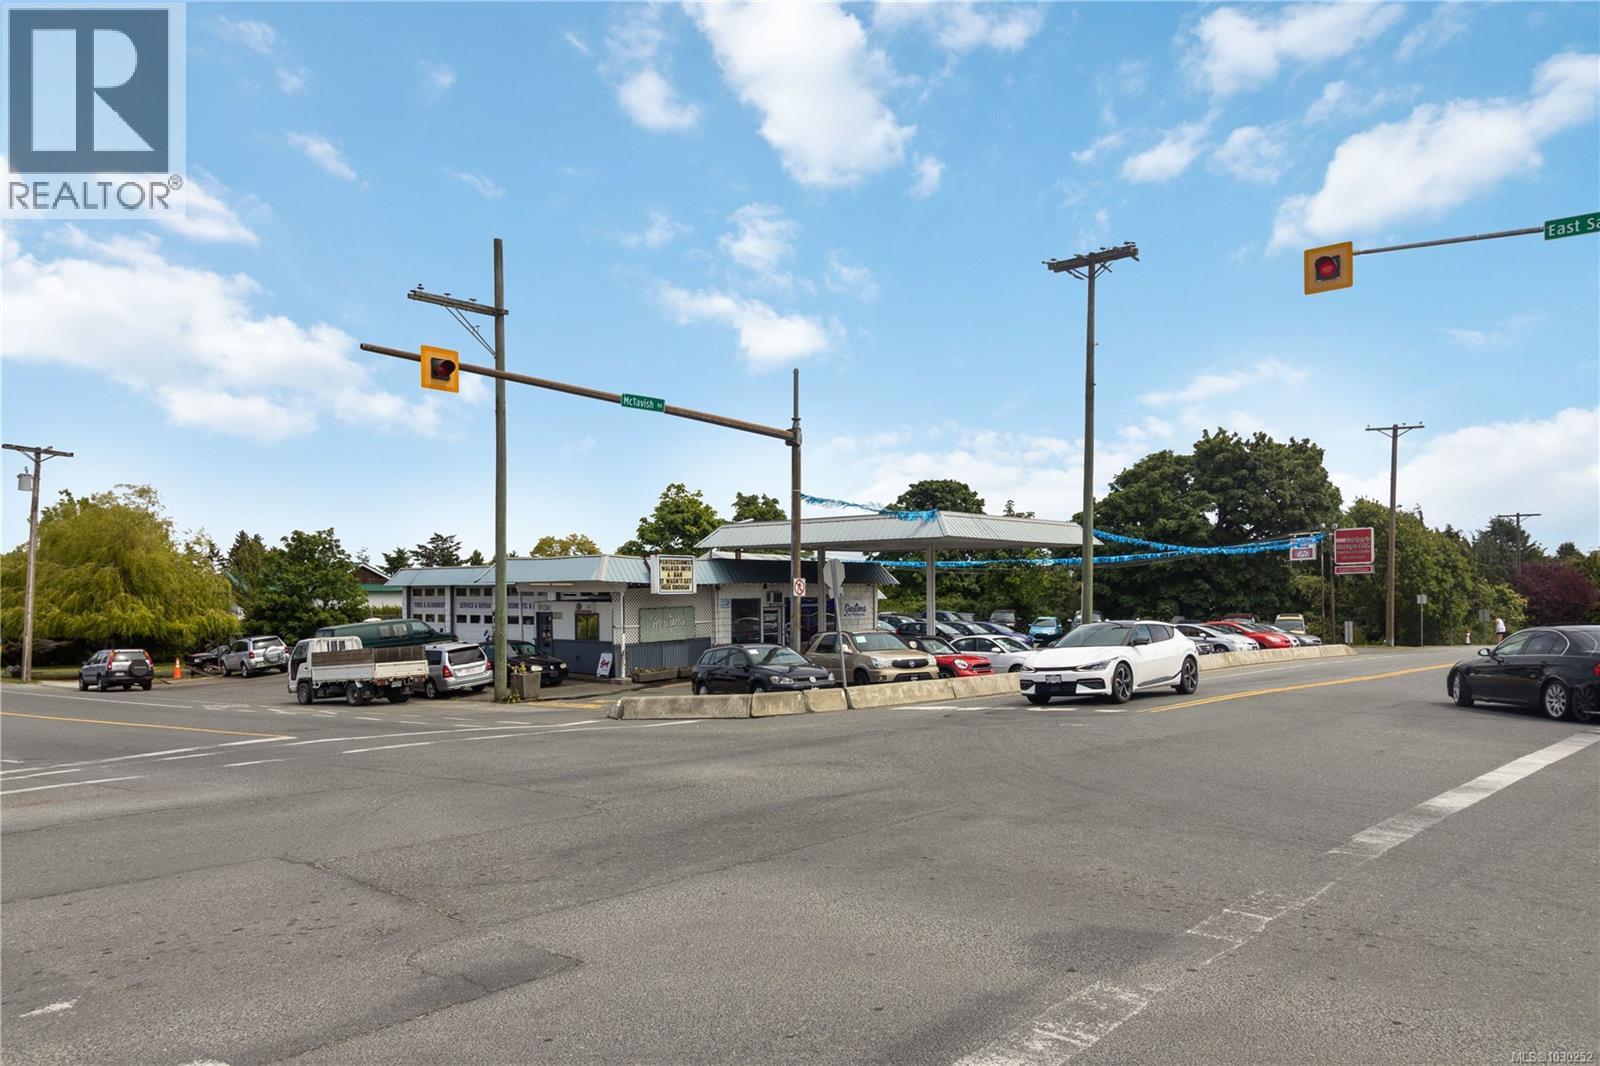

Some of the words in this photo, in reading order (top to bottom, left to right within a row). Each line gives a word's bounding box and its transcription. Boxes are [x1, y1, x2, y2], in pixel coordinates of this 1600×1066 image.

[1548, 220, 1580, 236] East
[623, 396, 654, 409] McTavish
[537, 603, 550, 611] 9139
